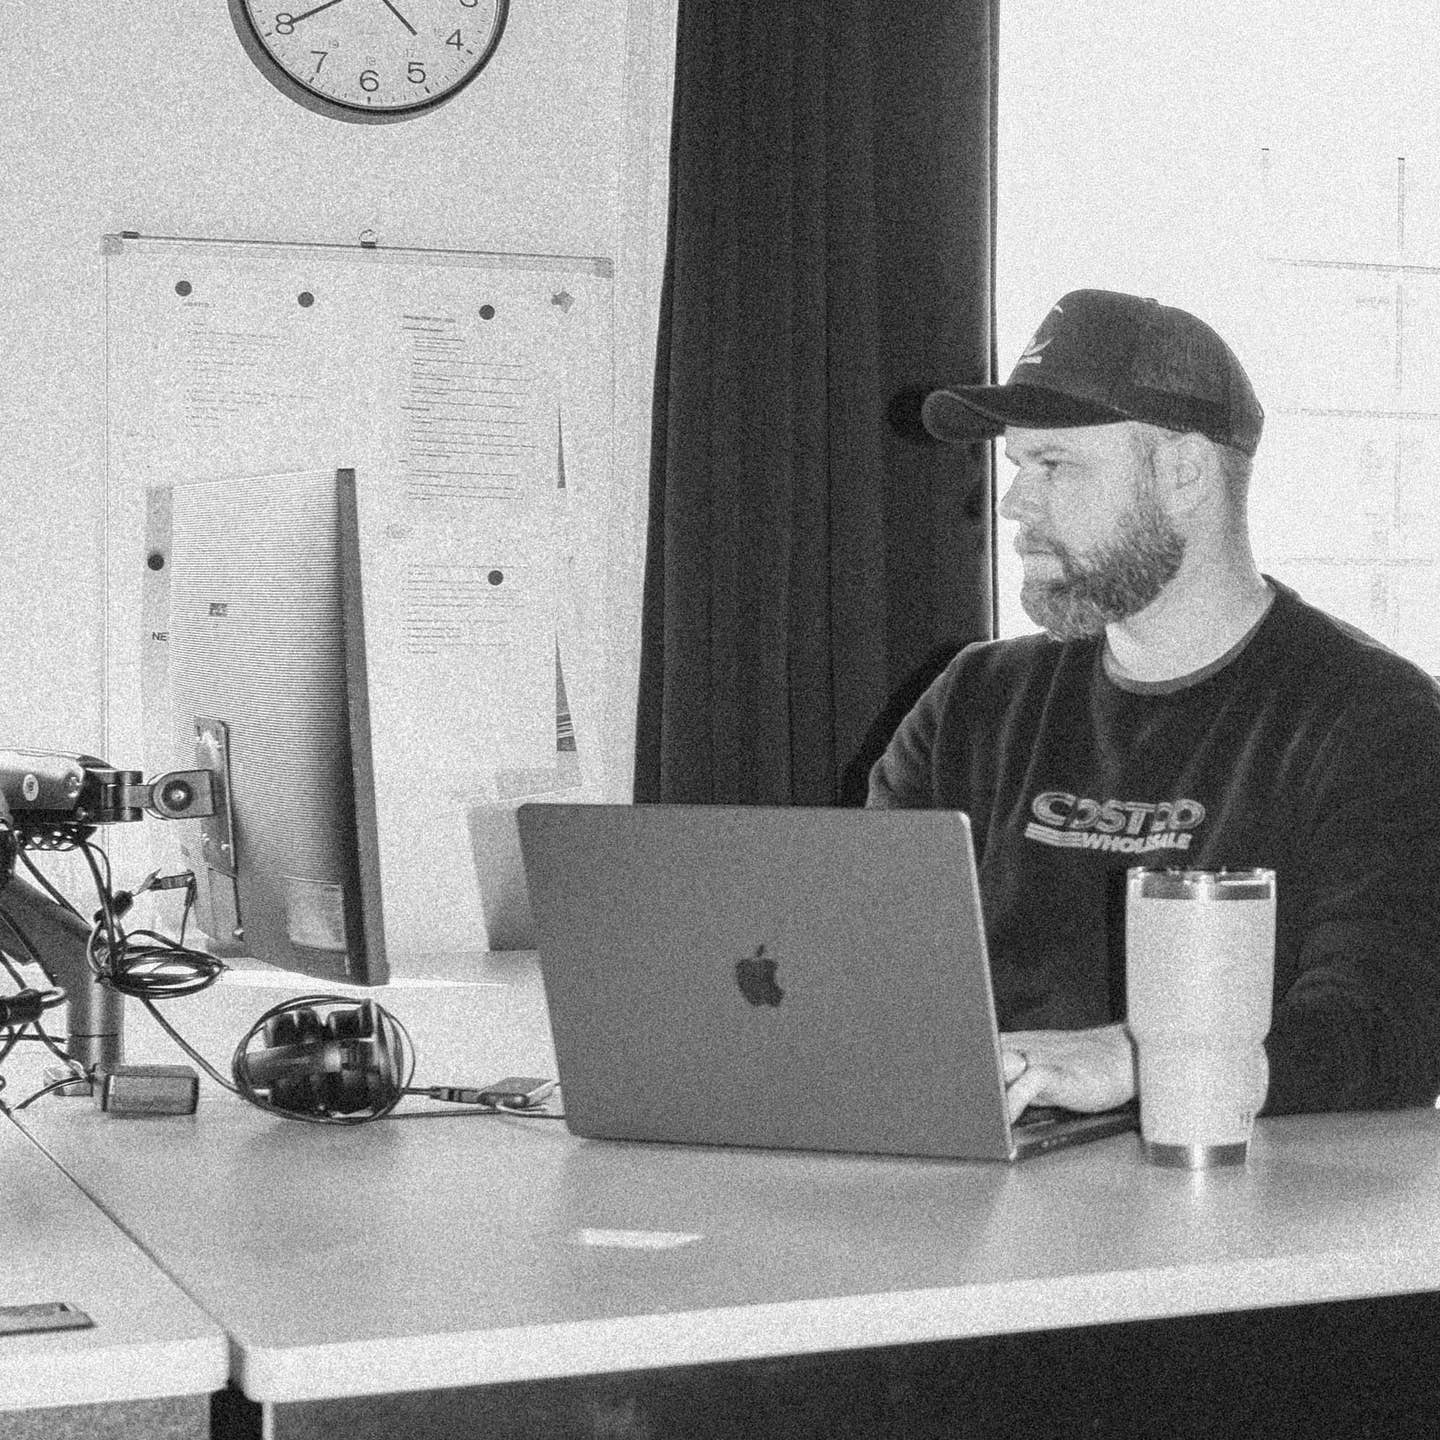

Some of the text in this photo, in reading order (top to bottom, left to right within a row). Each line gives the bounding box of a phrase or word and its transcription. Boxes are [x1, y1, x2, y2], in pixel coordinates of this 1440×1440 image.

[276, 13, 295, 35] 8
[445, 28, 465, 51] 4
[310, 50, 328, 74] 7
[407, 62, 426, 84] 5
[360, 69, 379, 92] 6
[152, 631, 169, 642] NE
